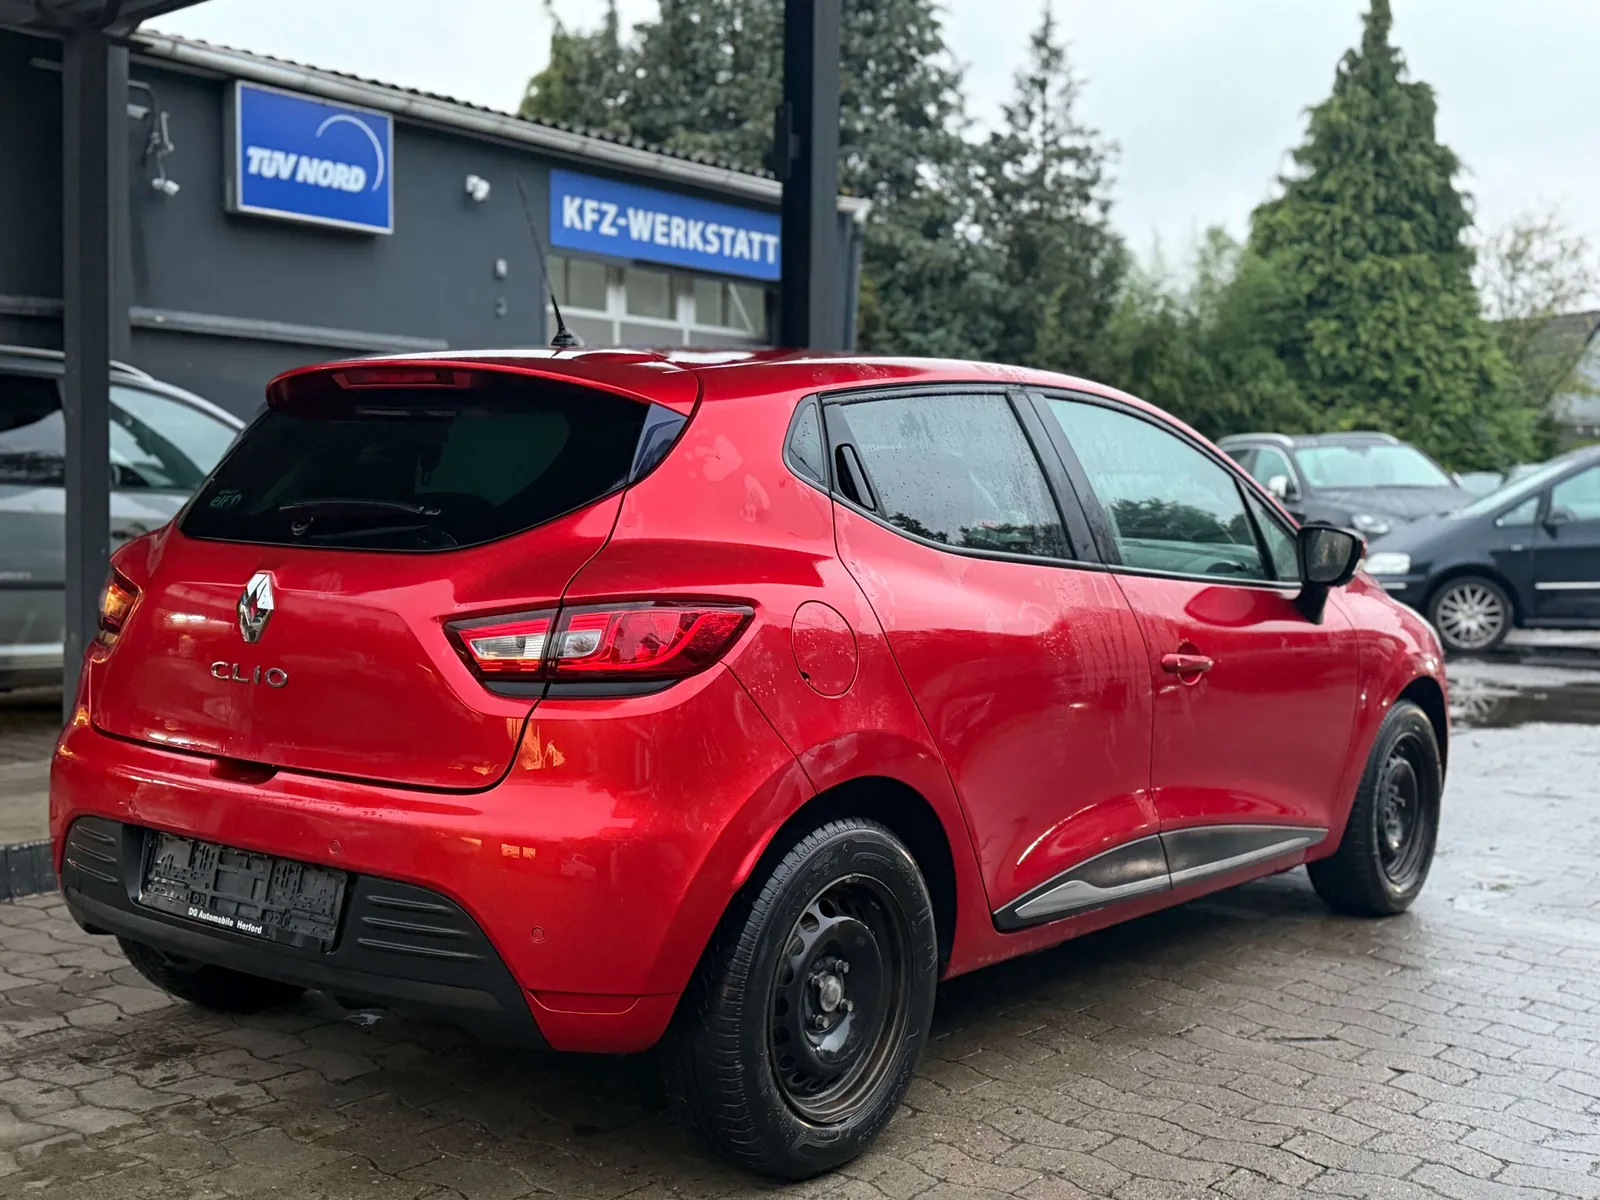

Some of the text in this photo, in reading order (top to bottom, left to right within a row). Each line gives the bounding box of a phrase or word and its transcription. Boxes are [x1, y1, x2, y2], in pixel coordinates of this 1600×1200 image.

[247, 146, 367, 193] TÜV NORD
[563, 194, 779, 264] KFZ-WERKSTATT
[211, 661, 288, 688] CLIO
[188, 907, 263, 934] DG Automobile Herford
